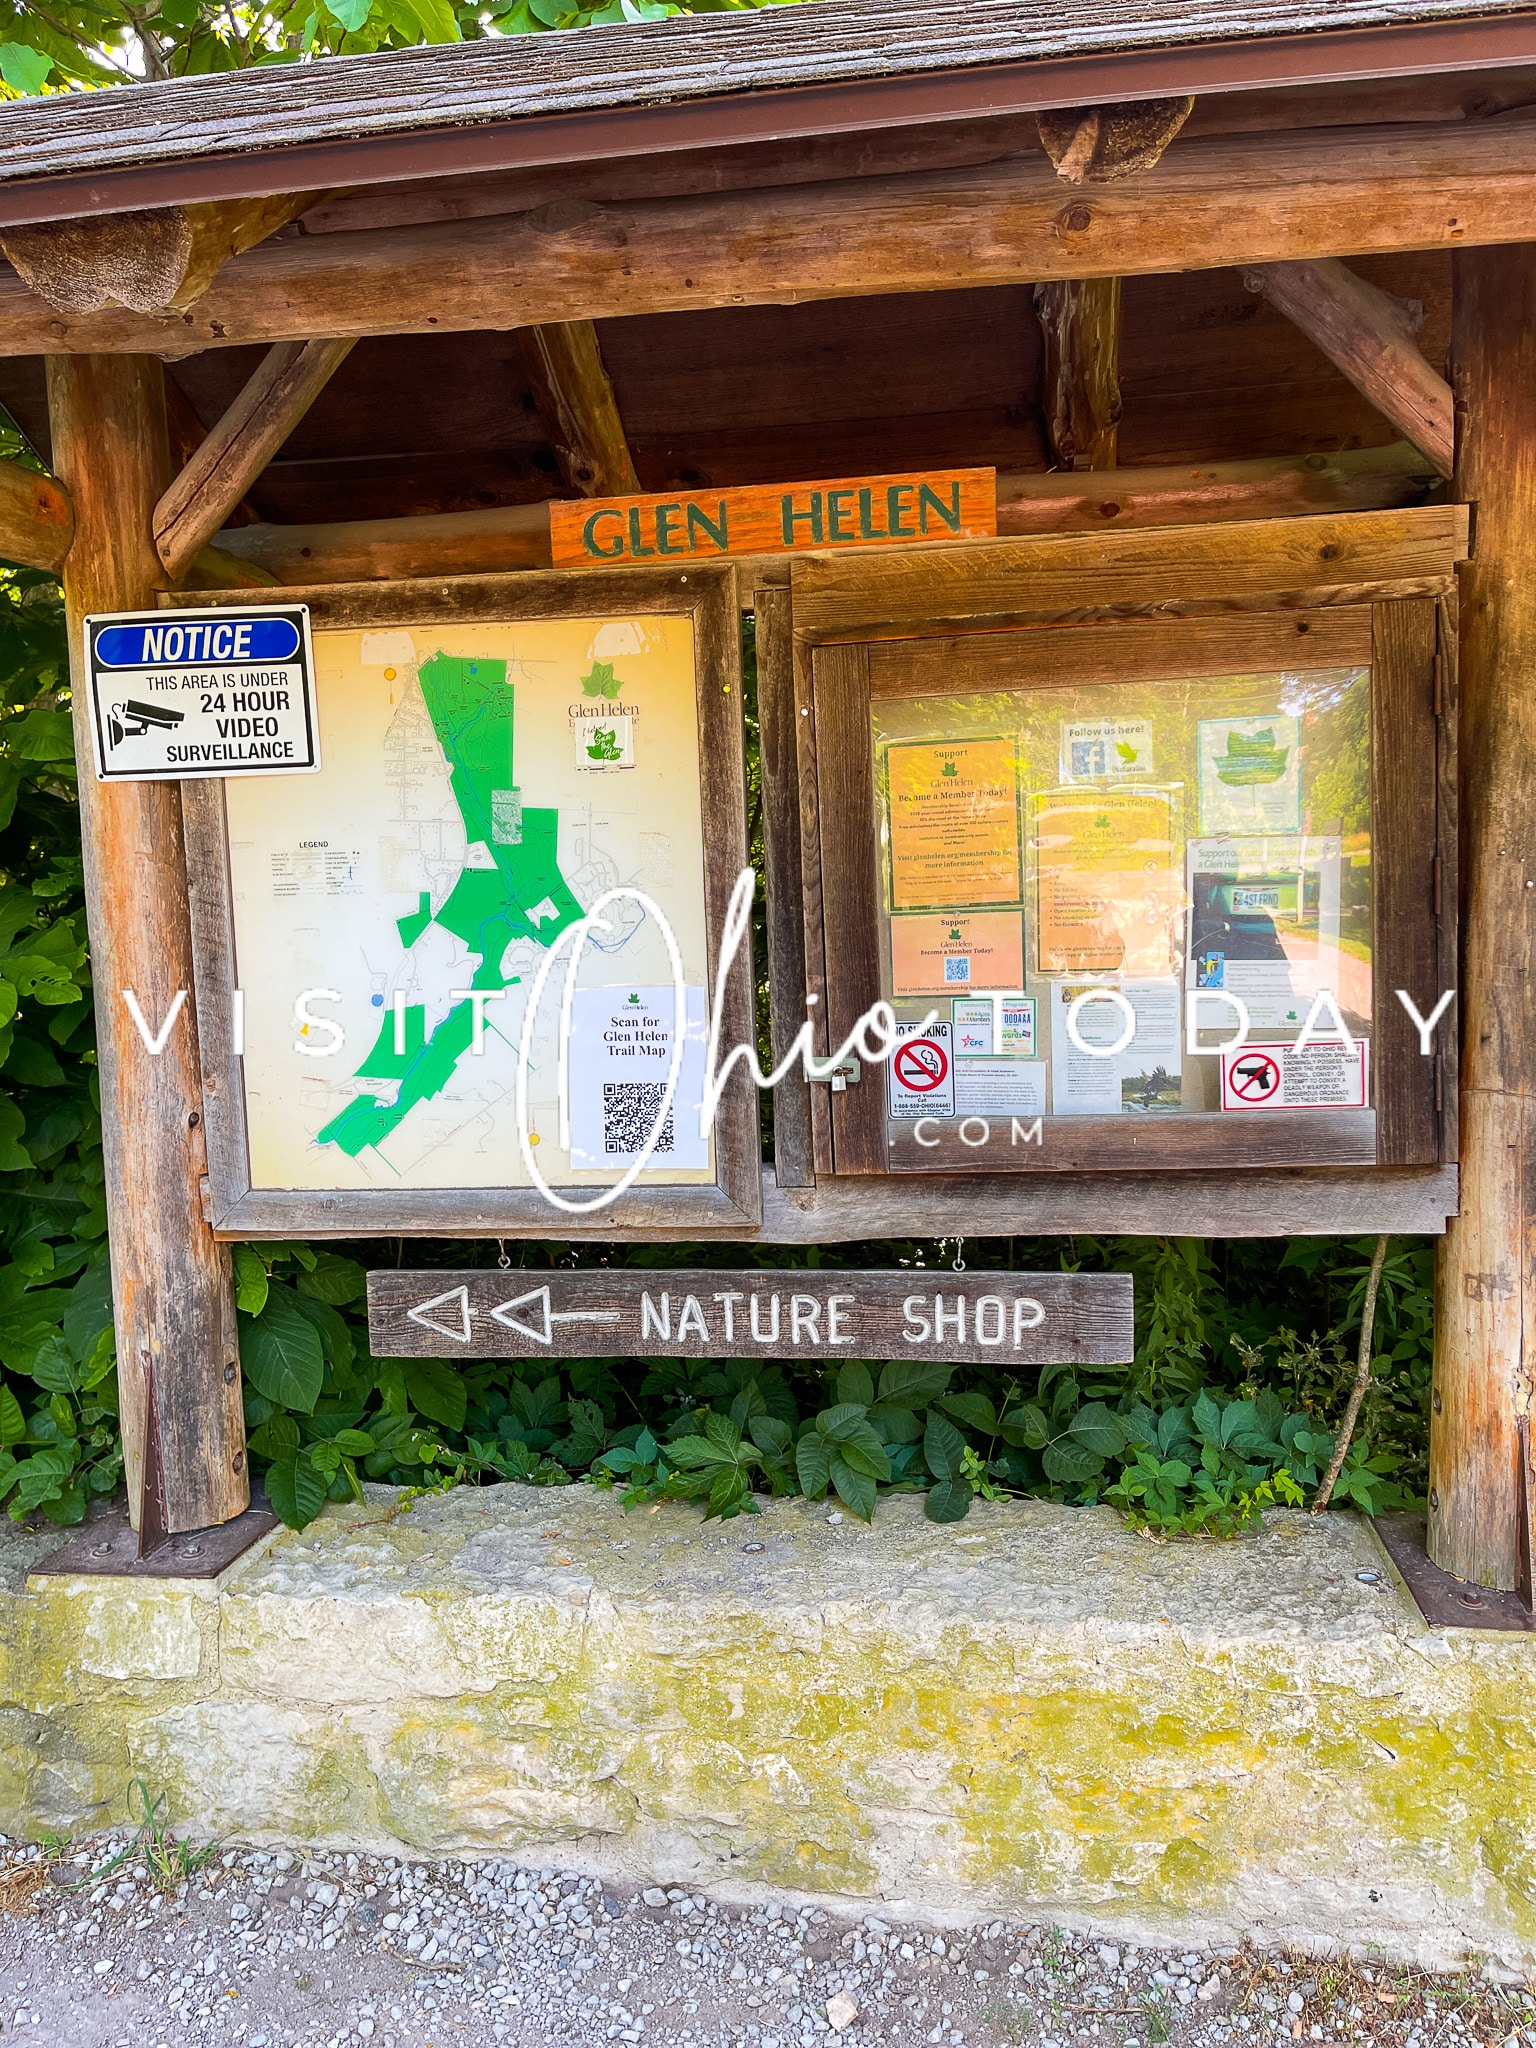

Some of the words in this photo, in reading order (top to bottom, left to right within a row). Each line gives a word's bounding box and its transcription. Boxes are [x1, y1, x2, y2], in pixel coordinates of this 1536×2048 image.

[583, 499, 728, 559] GLEN
[781, 481, 960, 547] HELEN
[141, 624, 253, 662] NOTICE
[146, 677, 178, 691] THIS
[181, 674, 219, 689] AREA
[223, 673, 236, 687] IS
[240, 672, 289, 687] UNDER
[200, 693, 226, 713] 24
[232, 690, 290, 711] HOUR
[568, 703, 599, 718] Glen
[601, 701, 640, 717] Helen
[216, 717, 279, 738] VIDEO
[1069, 727, 1101, 737] Follow
[1104, 727, 1116, 735] us
[1118, 725, 1145, 734] here!
[167, 741, 294, 762] SURVEILLANCE
[933, 749, 968, 759] Support
[930, 779, 949, 789] Glen
[949, 778, 974, 788] Helen
[898, 793, 931, 802] Become
[940, 790, 975, 800] Member
[978, 788, 1008, 797] Today!
[1104, 800, 1125, 808] Glen
[1127, 799, 1158, 808] Helen!
[299, 840, 329, 849] LEGEND
[1197, 848, 1231, 859] Support
[925, 861, 943, 869] more
[943, 860, 984, 868] information
[1204, 860, 1223, 868] Glen
[940, 919, 970, 927] Support
[955, 940, 973, 948] Helen
[611, 1016, 639, 1028] Scan
[642, 1016, 660, 1027] for
[603, 1031, 631, 1042] Glen
[635, 1031, 668, 1041] Helen
[607, 1045, 635, 1056] Trail
[639, 1045, 666, 1058] Map
[640, 1291, 855, 1345] NATURE
[902, 1295, 1045, 1351] SHOP
